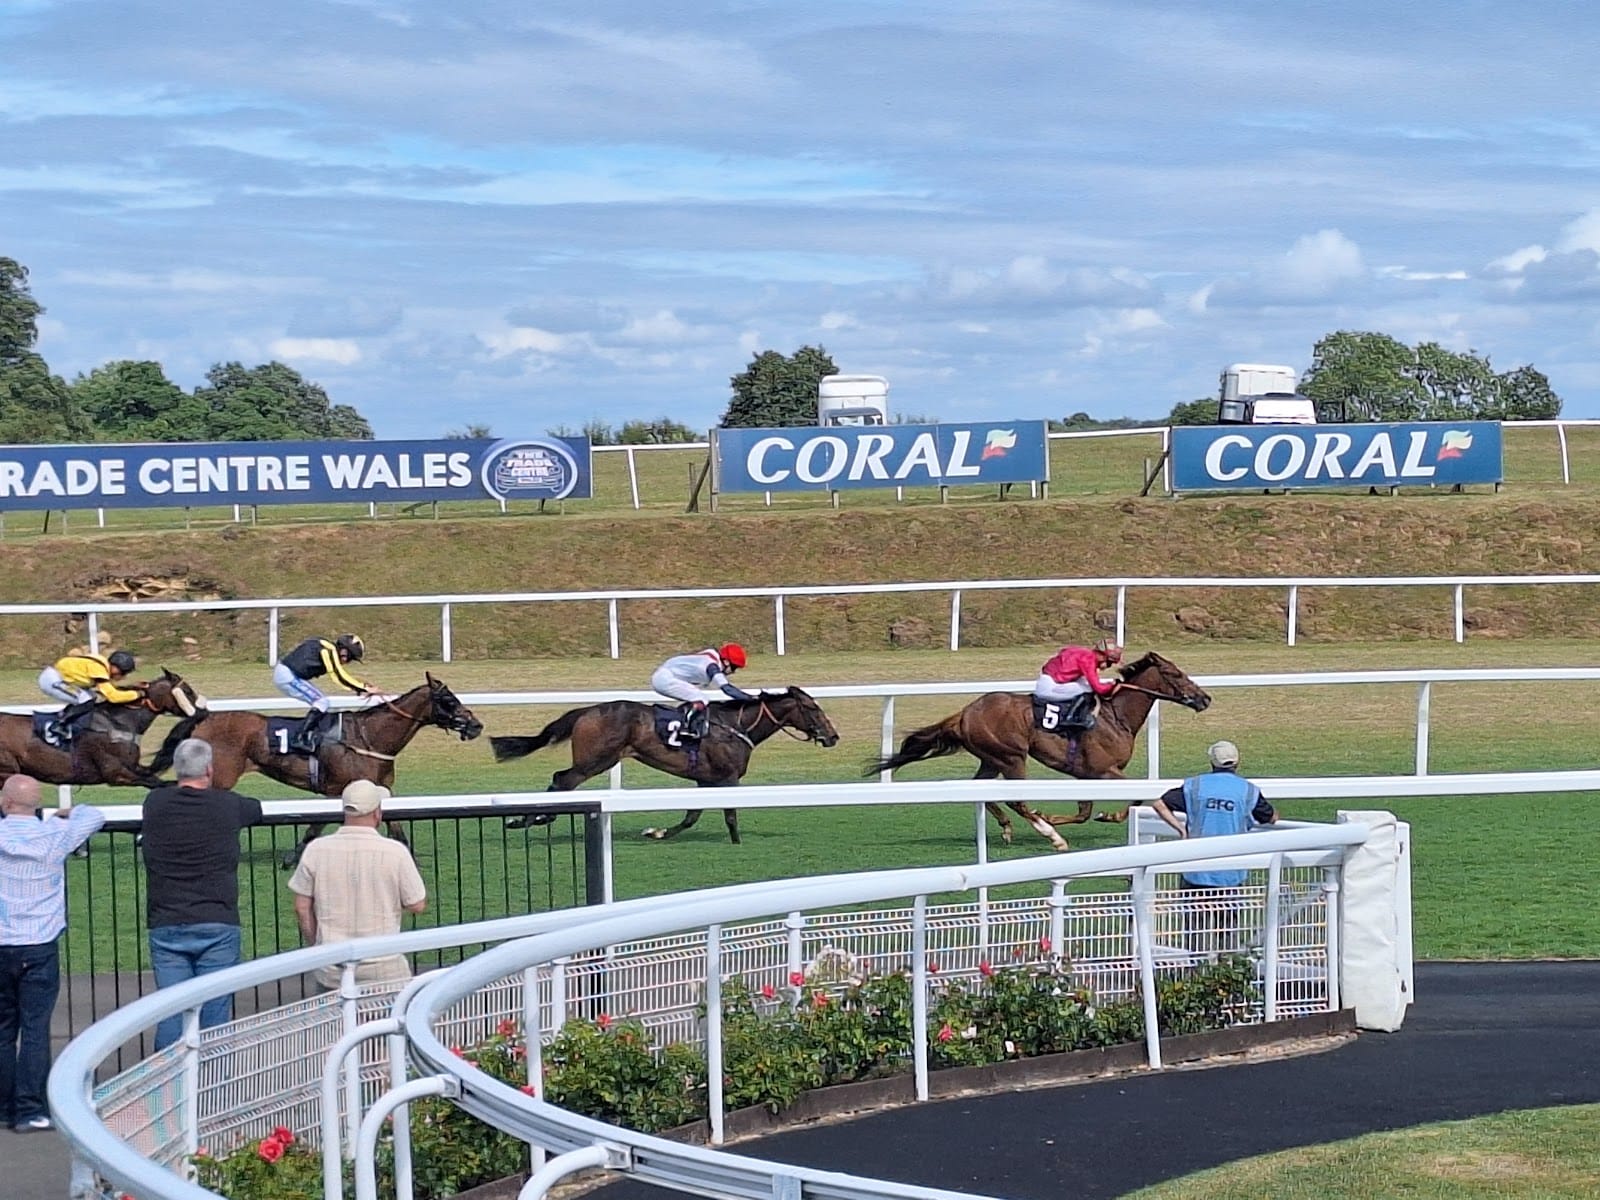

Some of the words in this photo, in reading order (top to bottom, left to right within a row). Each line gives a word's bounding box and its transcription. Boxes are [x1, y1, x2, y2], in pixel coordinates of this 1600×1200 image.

[746, 430, 981, 484] CORAL
[1205, 430, 1436, 481] CORAL
[0, 459, 126, 497] RADE
[138, 455, 311, 494] CENTRE
[322, 452, 472, 489] WALES
[668, 720, 682, 747] 2
[1042, 703, 1060, 729] 5
[275, 728, 288, 754] 1
